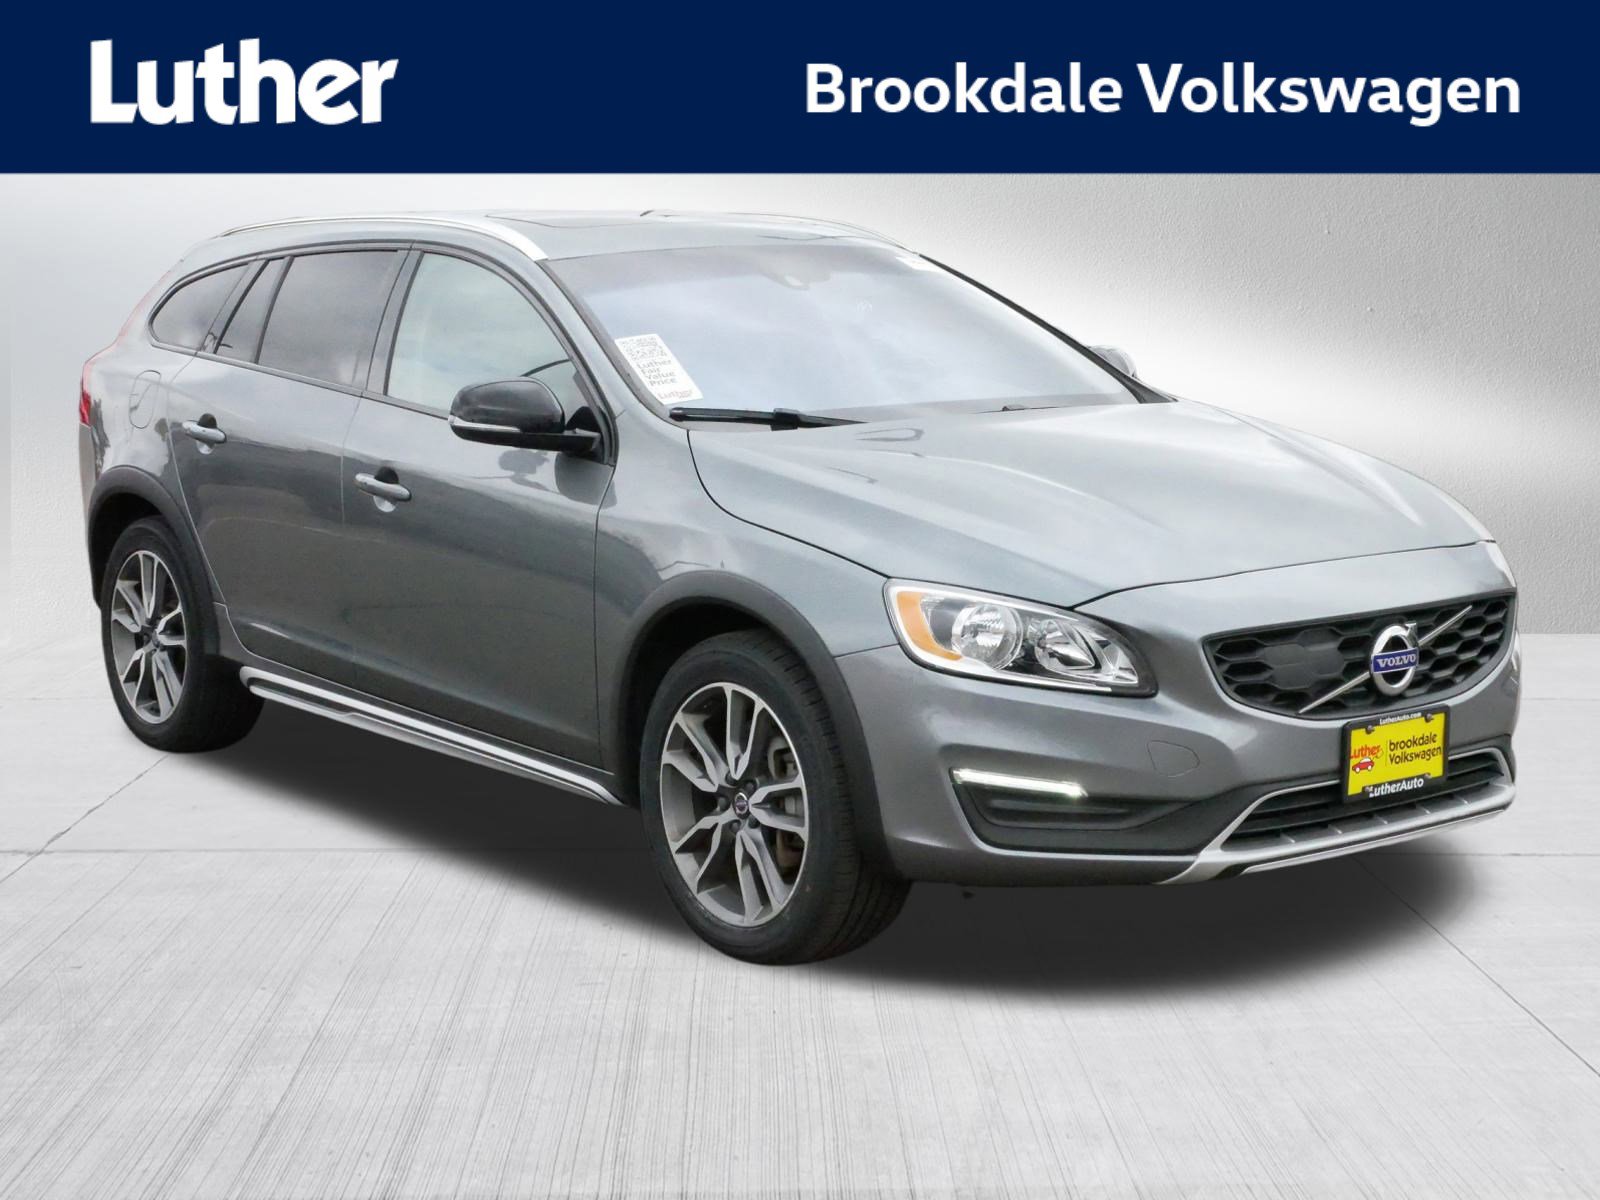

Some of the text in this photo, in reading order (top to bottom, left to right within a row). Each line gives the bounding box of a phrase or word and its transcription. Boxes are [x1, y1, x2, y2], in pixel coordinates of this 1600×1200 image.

[637, 359, 672, 369] Luther
[641, 366, 661, 375] Fair
[646, 371, 677, 380] Value
[649, 378, 677, 387] Price
[1377, 654, 1416, 668] VOLVO
[1380, 712, 1422, 724] LutherAuto.com
[1389, 732, 1437, 751] brookdale
[1389, 746, 1442, 765] Volkswagen
[1369, 778, 1424, 798] LutherAuto
